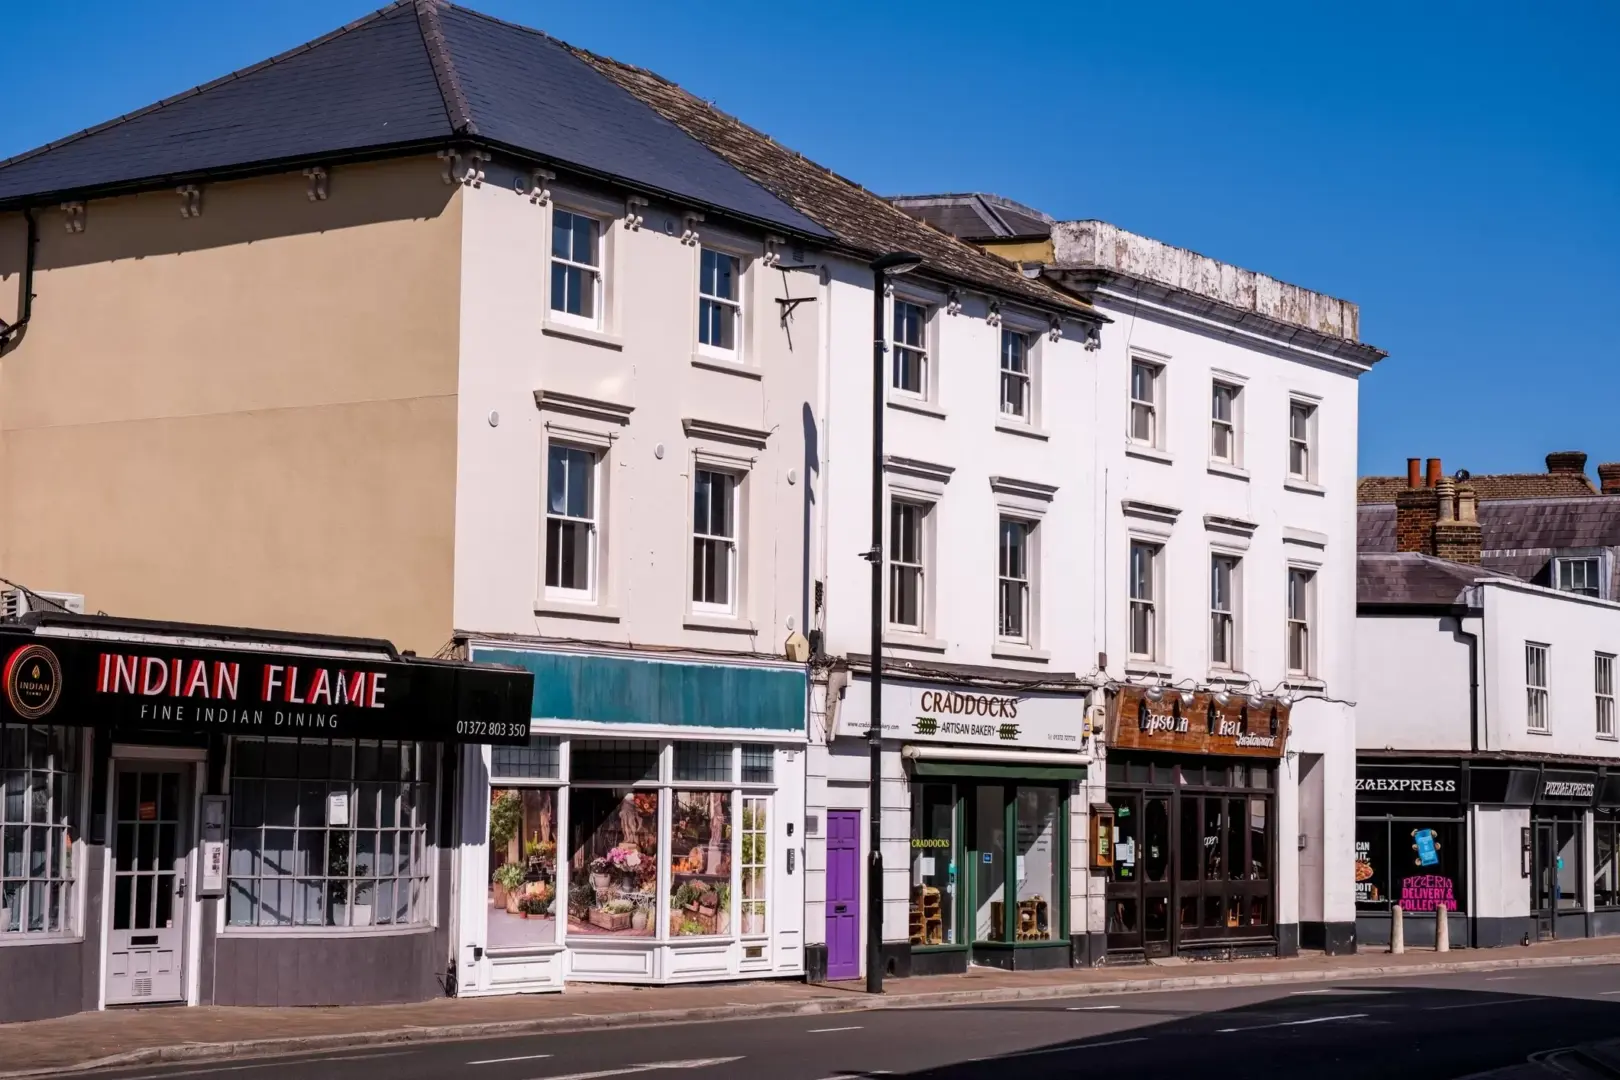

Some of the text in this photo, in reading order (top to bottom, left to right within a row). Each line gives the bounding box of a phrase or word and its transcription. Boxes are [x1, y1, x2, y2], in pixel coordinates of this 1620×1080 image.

[20, 681, 50, 692] INDIAN
[97, 653, 387, 709] INDIAN FLAME
[921, 691, 1018, 718] CRADDOCKS
[140, 704, 338, 728] FINE INDIAN DINING
[1140, 708, 1189, 736] Epsom
[1209, 710, 1242, 736] Thai
[456, 720, 526, 737] 01372 803 350
[941, 722, 996, 736] ARTISAN BAKERY
[1544, 781, 1595, 797] PIZZAEXPRESS
[911, 838, 950, 848] CRADDOCKS
[1356, 841, 1370, 851] CAN
[1403, 874, 1453, 888] PIZZERIA
[1402, 887, 1454, 899] DELIVERY &
